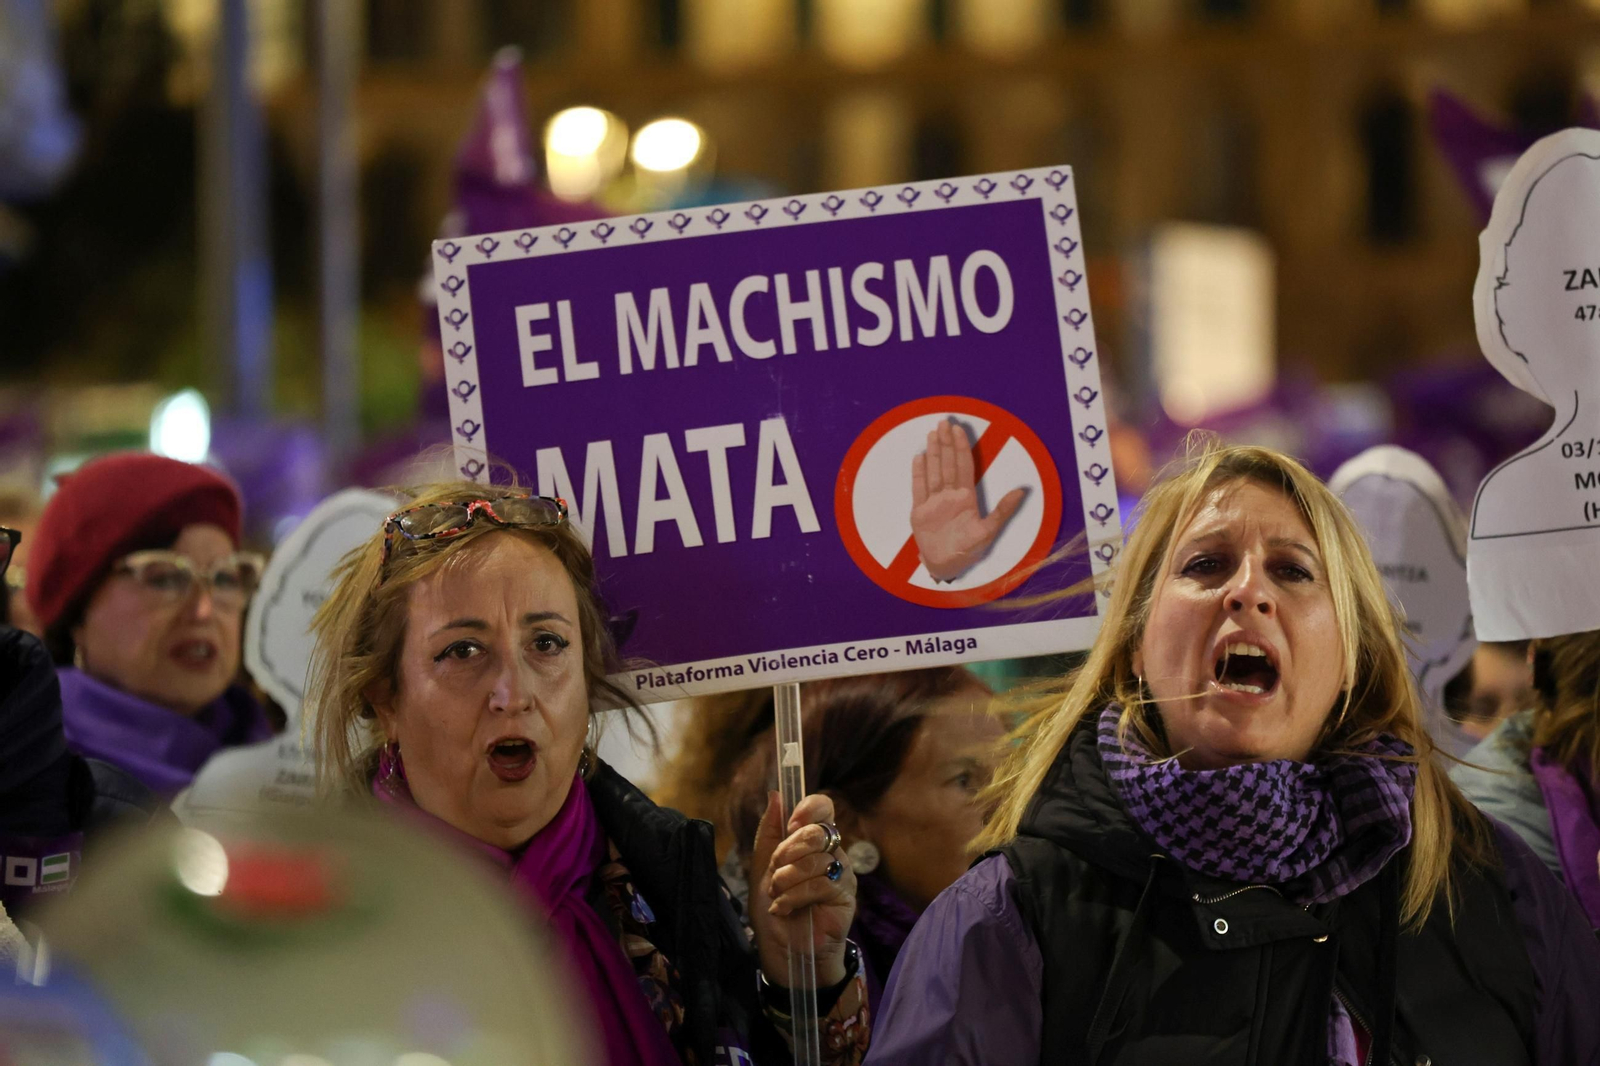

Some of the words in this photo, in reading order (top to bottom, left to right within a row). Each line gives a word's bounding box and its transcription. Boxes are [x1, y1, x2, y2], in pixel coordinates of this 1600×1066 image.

[1563, 267, 1600, 291] ZA
[515, 299, 600, 388] EL
[614, 249, 1014, 375] MACHISMO
[1574, 304, 1600, 321] 47
[1561, 438, 1600, 459] 03/
[536, 416, 821, 558] MATA
[1575, 471, 1600, 490] M
[636, 663, 744, 690] Plataforma
[748, 649, 839, 673] Violencia
[844, 646, 889, 662] Cero
[905, 636, 977, 655] Málaga
